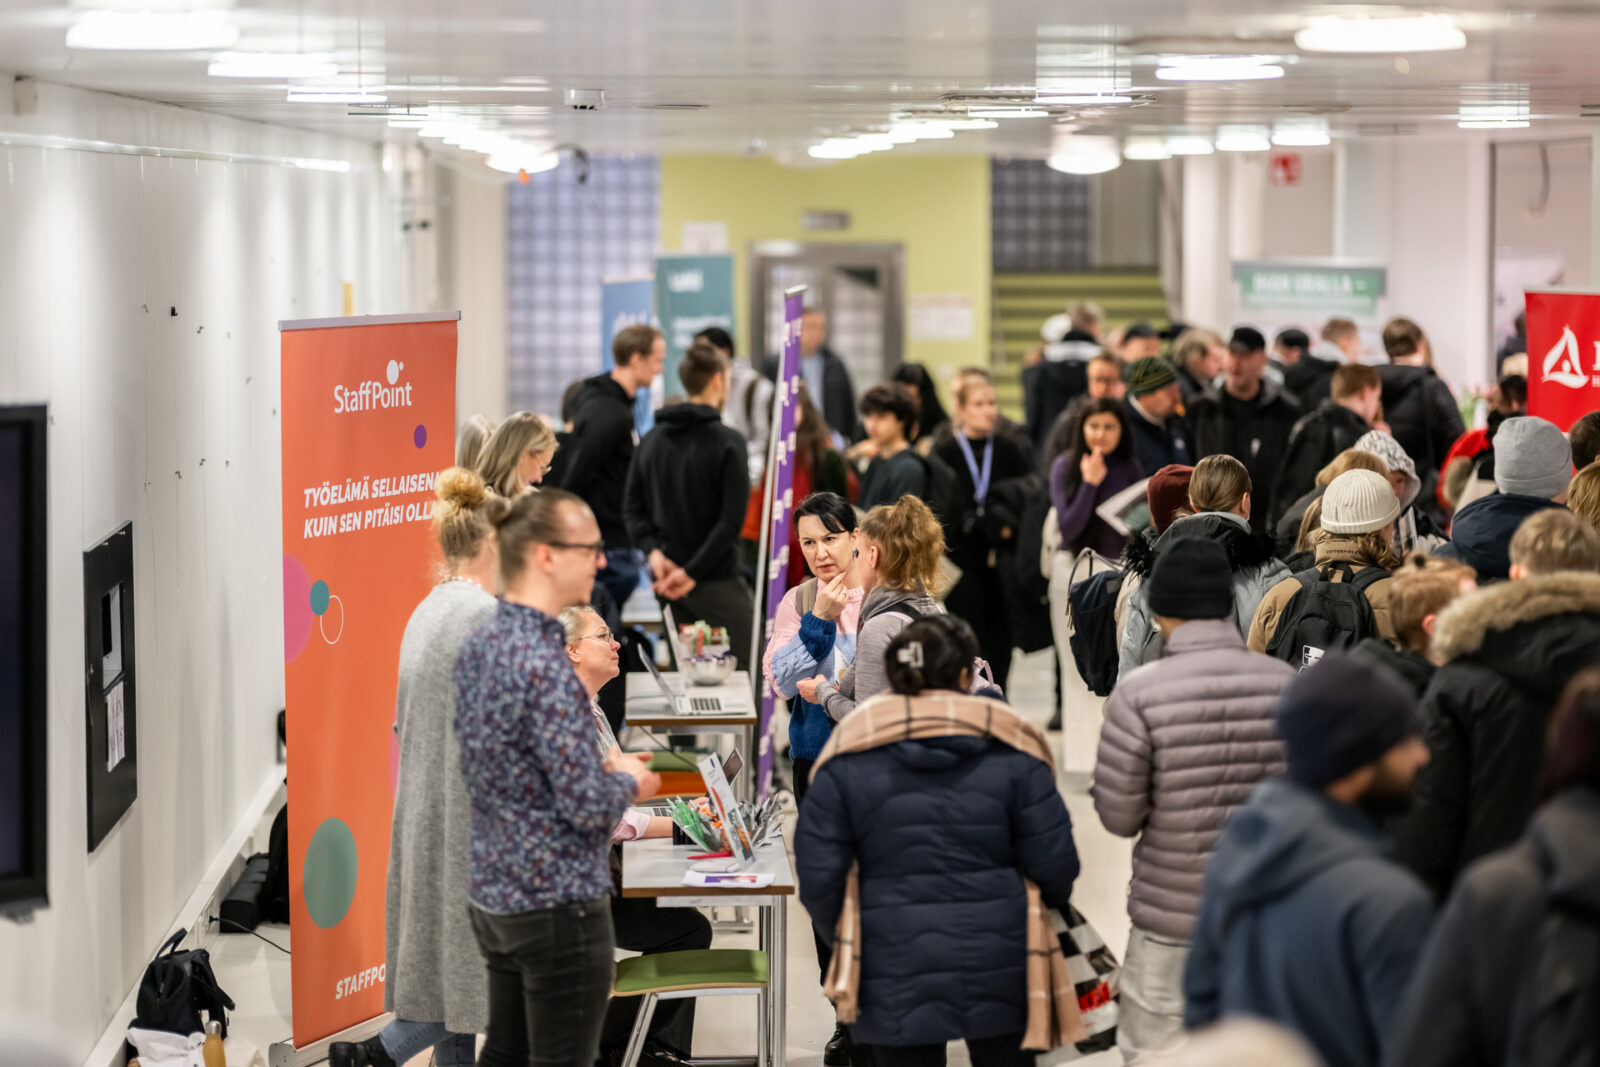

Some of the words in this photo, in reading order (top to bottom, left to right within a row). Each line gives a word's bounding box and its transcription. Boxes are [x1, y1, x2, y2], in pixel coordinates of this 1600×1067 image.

[333, 360, 413, 414] StaffPoint
[303, 475, 370, 509] TYÖELÄMÄ
[303, 515, 338, 539] KUIN
[338, 511, 362, 534] SEN
[364, 502, 405, 530] PITÄISI
